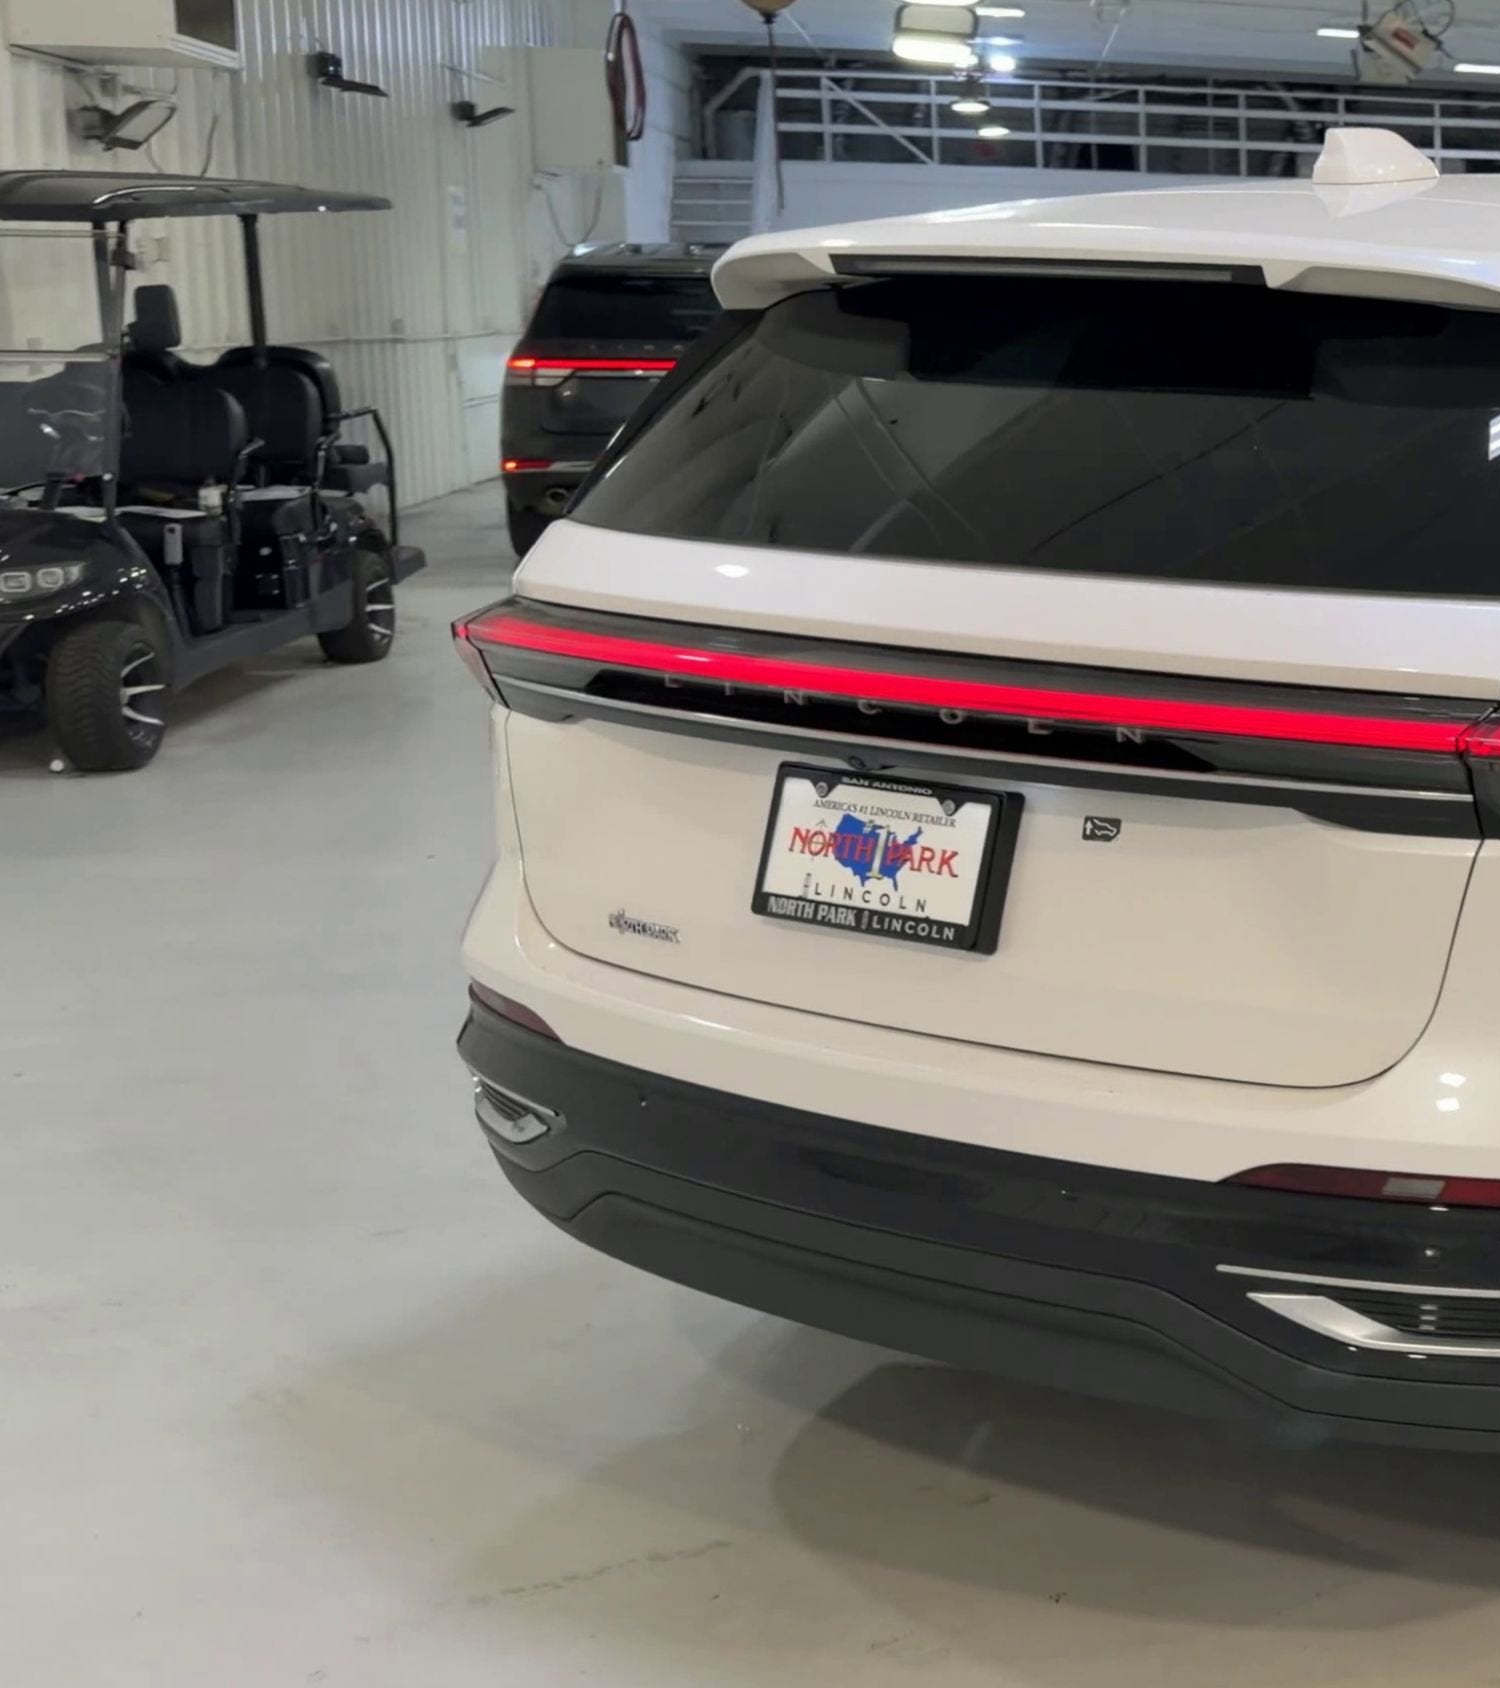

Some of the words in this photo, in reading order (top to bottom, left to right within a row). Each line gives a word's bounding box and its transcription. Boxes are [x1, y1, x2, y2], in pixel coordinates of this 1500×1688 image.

[664, 673, 1145, 744] LINCOLN
[841, 776, 869, 787] SAN
[871, 781, 933, 795] ANTONIO
[869, 806, 910, 820] LINCOLN
[911, 813, 956, 828] RETAILER
[788, 827, 877, 863] NORTH
[885, 837, 960, 878] PARK
[814, 882, 928, 912] LINCOLN
[767, 896, 815, 919] NORTH
[816, 904, 857, 926] PARK
[871, 915, 955, 941] LINCOLN
